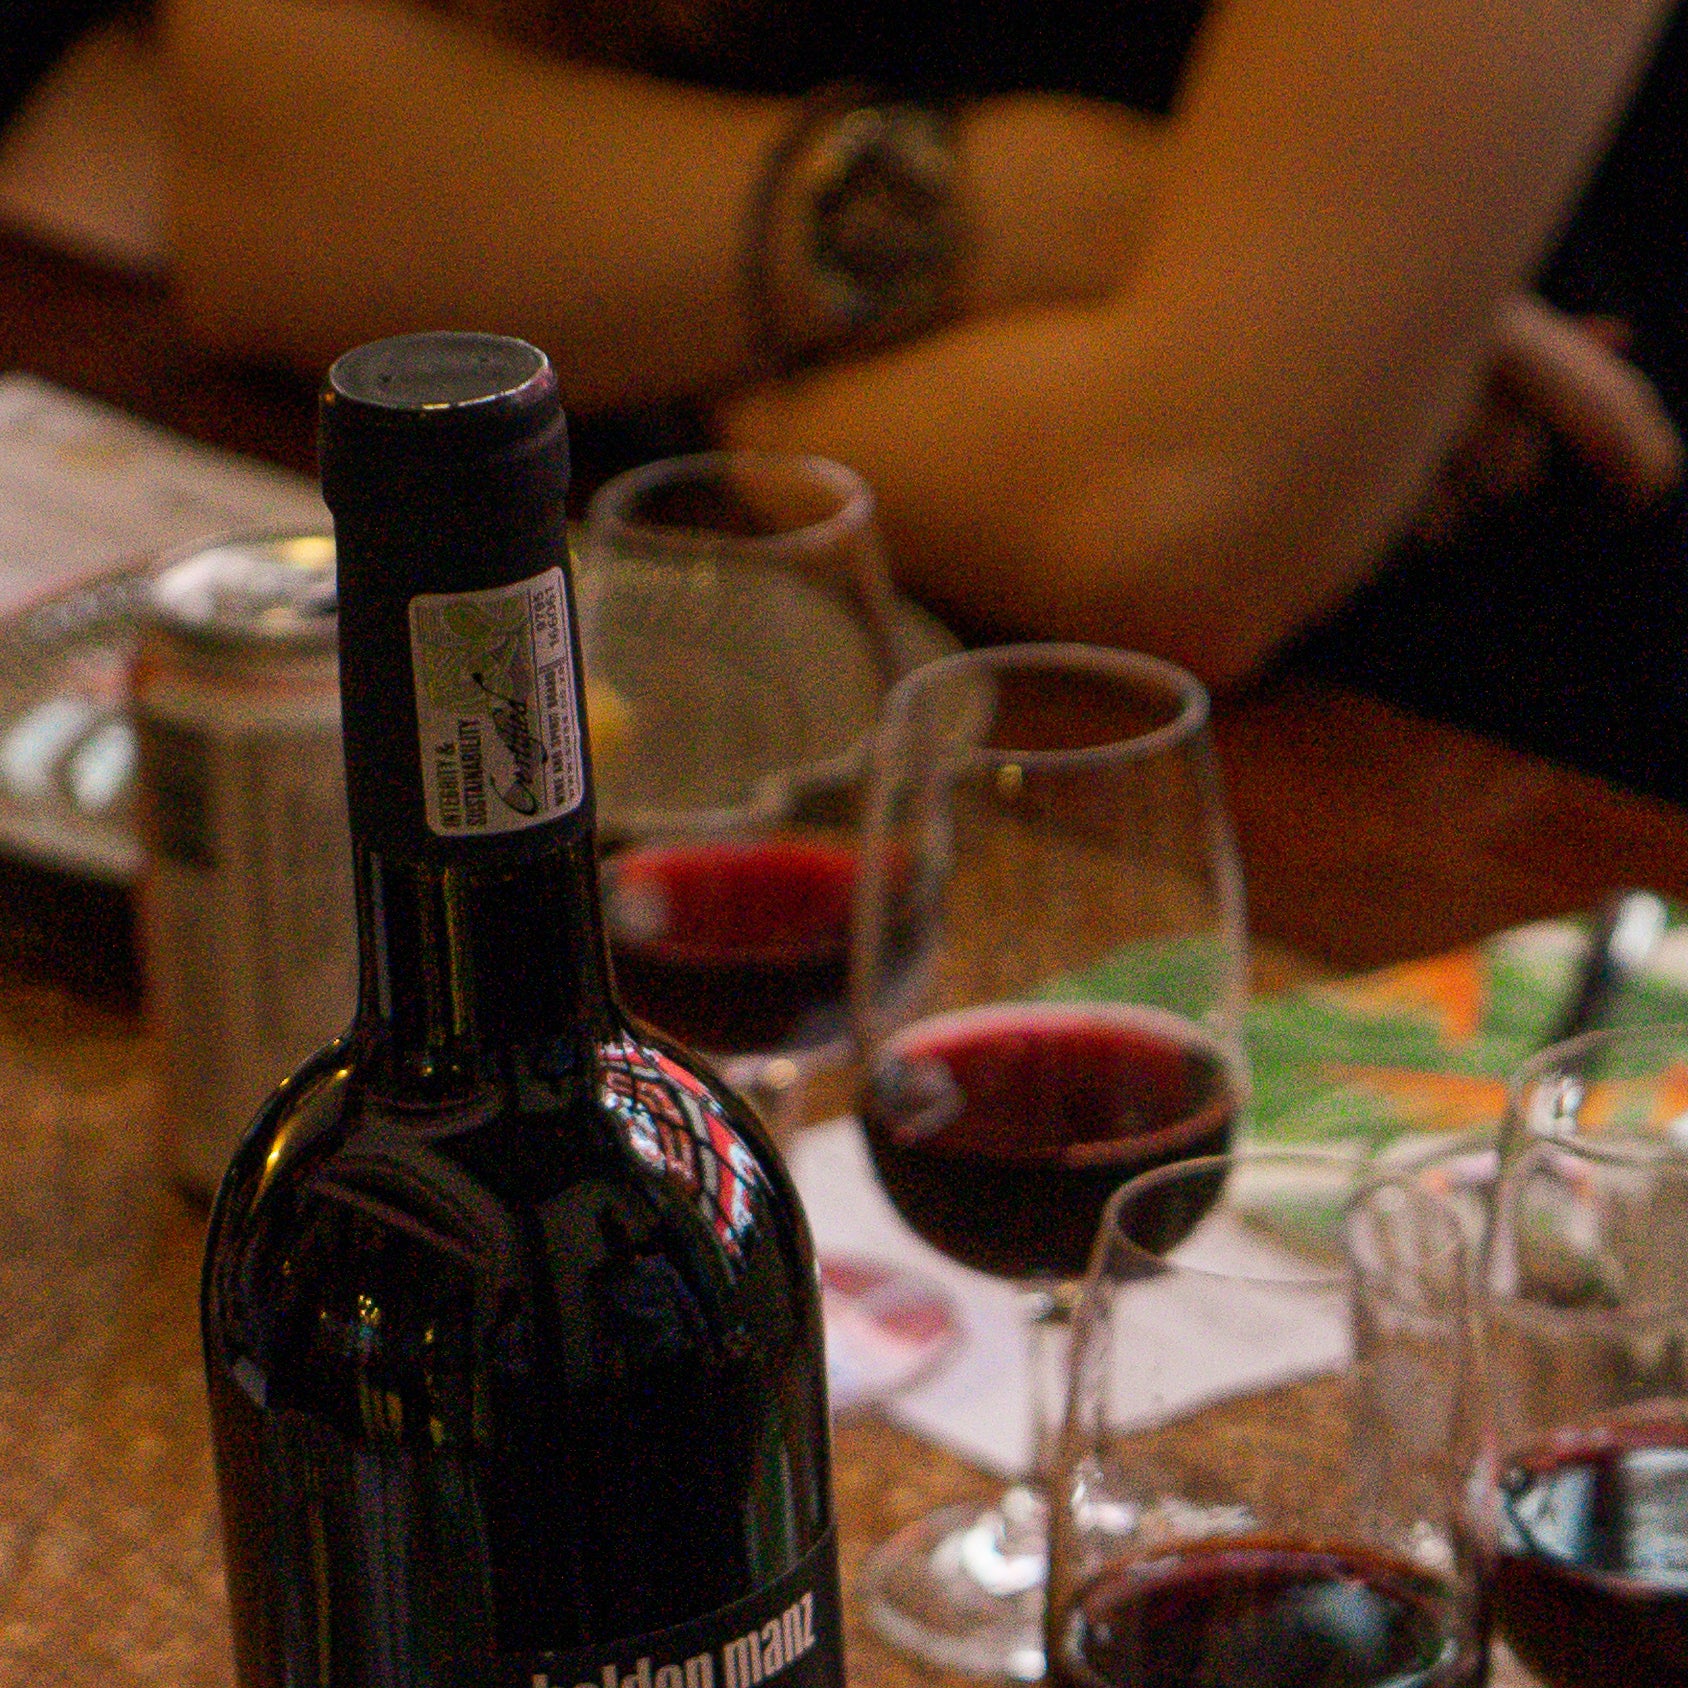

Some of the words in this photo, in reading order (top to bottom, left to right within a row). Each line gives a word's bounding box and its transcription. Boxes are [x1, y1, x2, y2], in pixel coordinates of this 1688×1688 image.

[434, 742, 456, 756] &
[456, 718, 488, 828] SUSTAINABILITY
[471, 671, 549, 817] Certified
[435, 760, 461, 829] INTEGRITY
